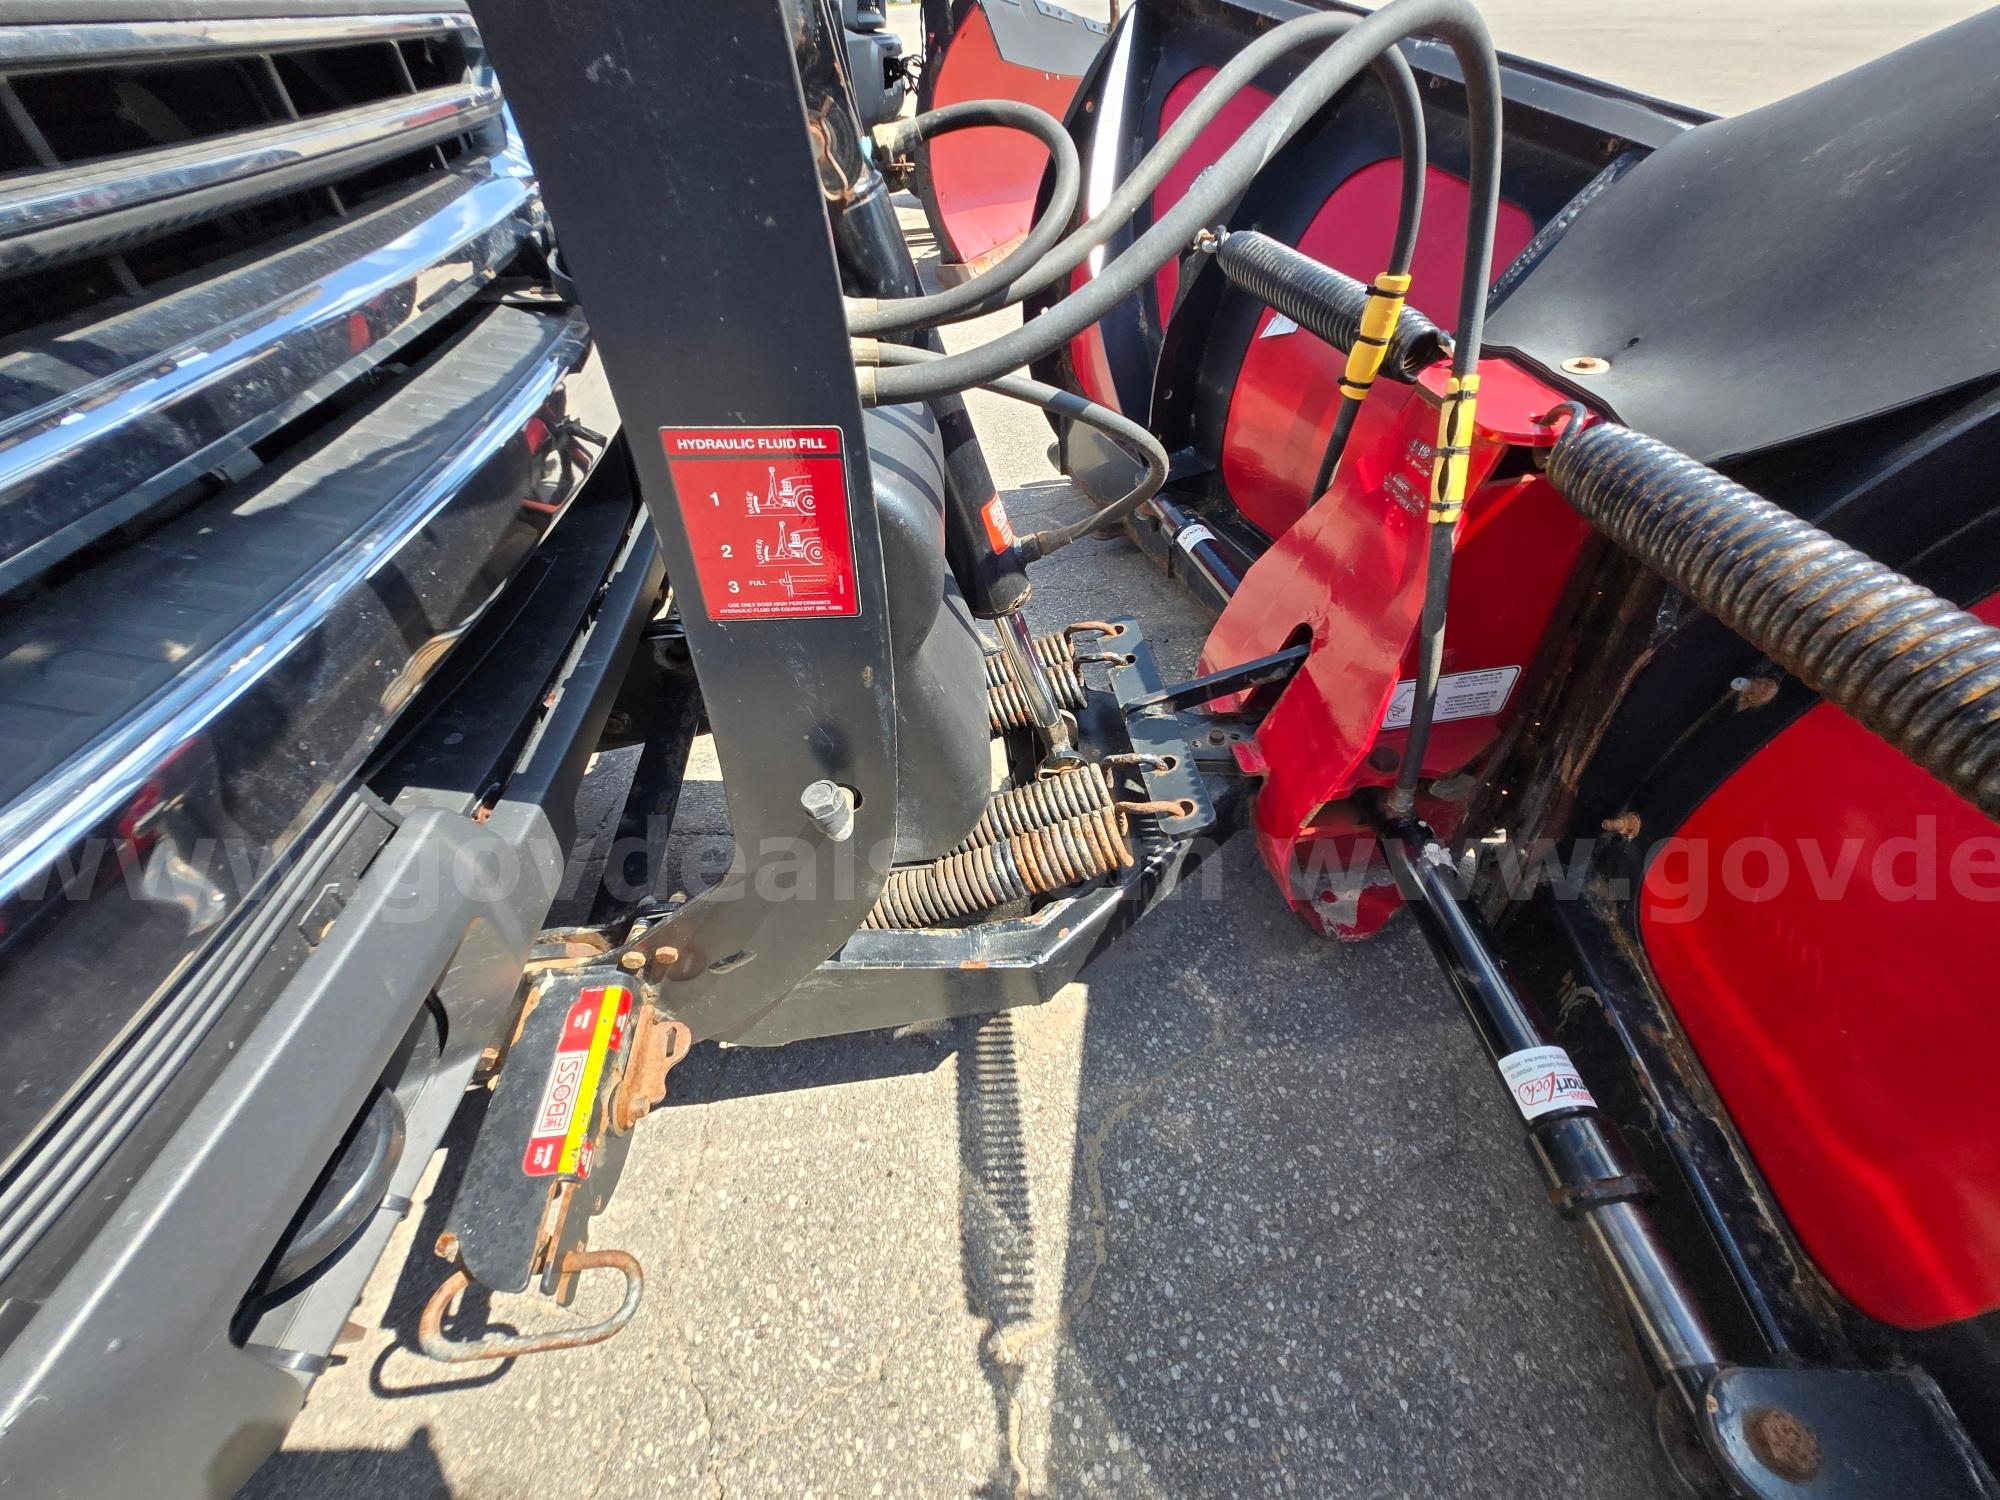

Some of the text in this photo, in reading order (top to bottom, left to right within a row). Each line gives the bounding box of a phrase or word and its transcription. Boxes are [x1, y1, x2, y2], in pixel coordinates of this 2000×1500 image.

[677, 438, 827, 450] HYDRAULIC FLUID FILL
[709, 492, 720, 507] 1
[746, 491, 754, 515] RAISE
[720, 545, 733, 558] 2
[756, 539, 764, 565] LOWER
[728, 580, 740, 594] 3
[546, 1060, 578, 1117] BOSS
[543, 1118, 563, 1128] THE
